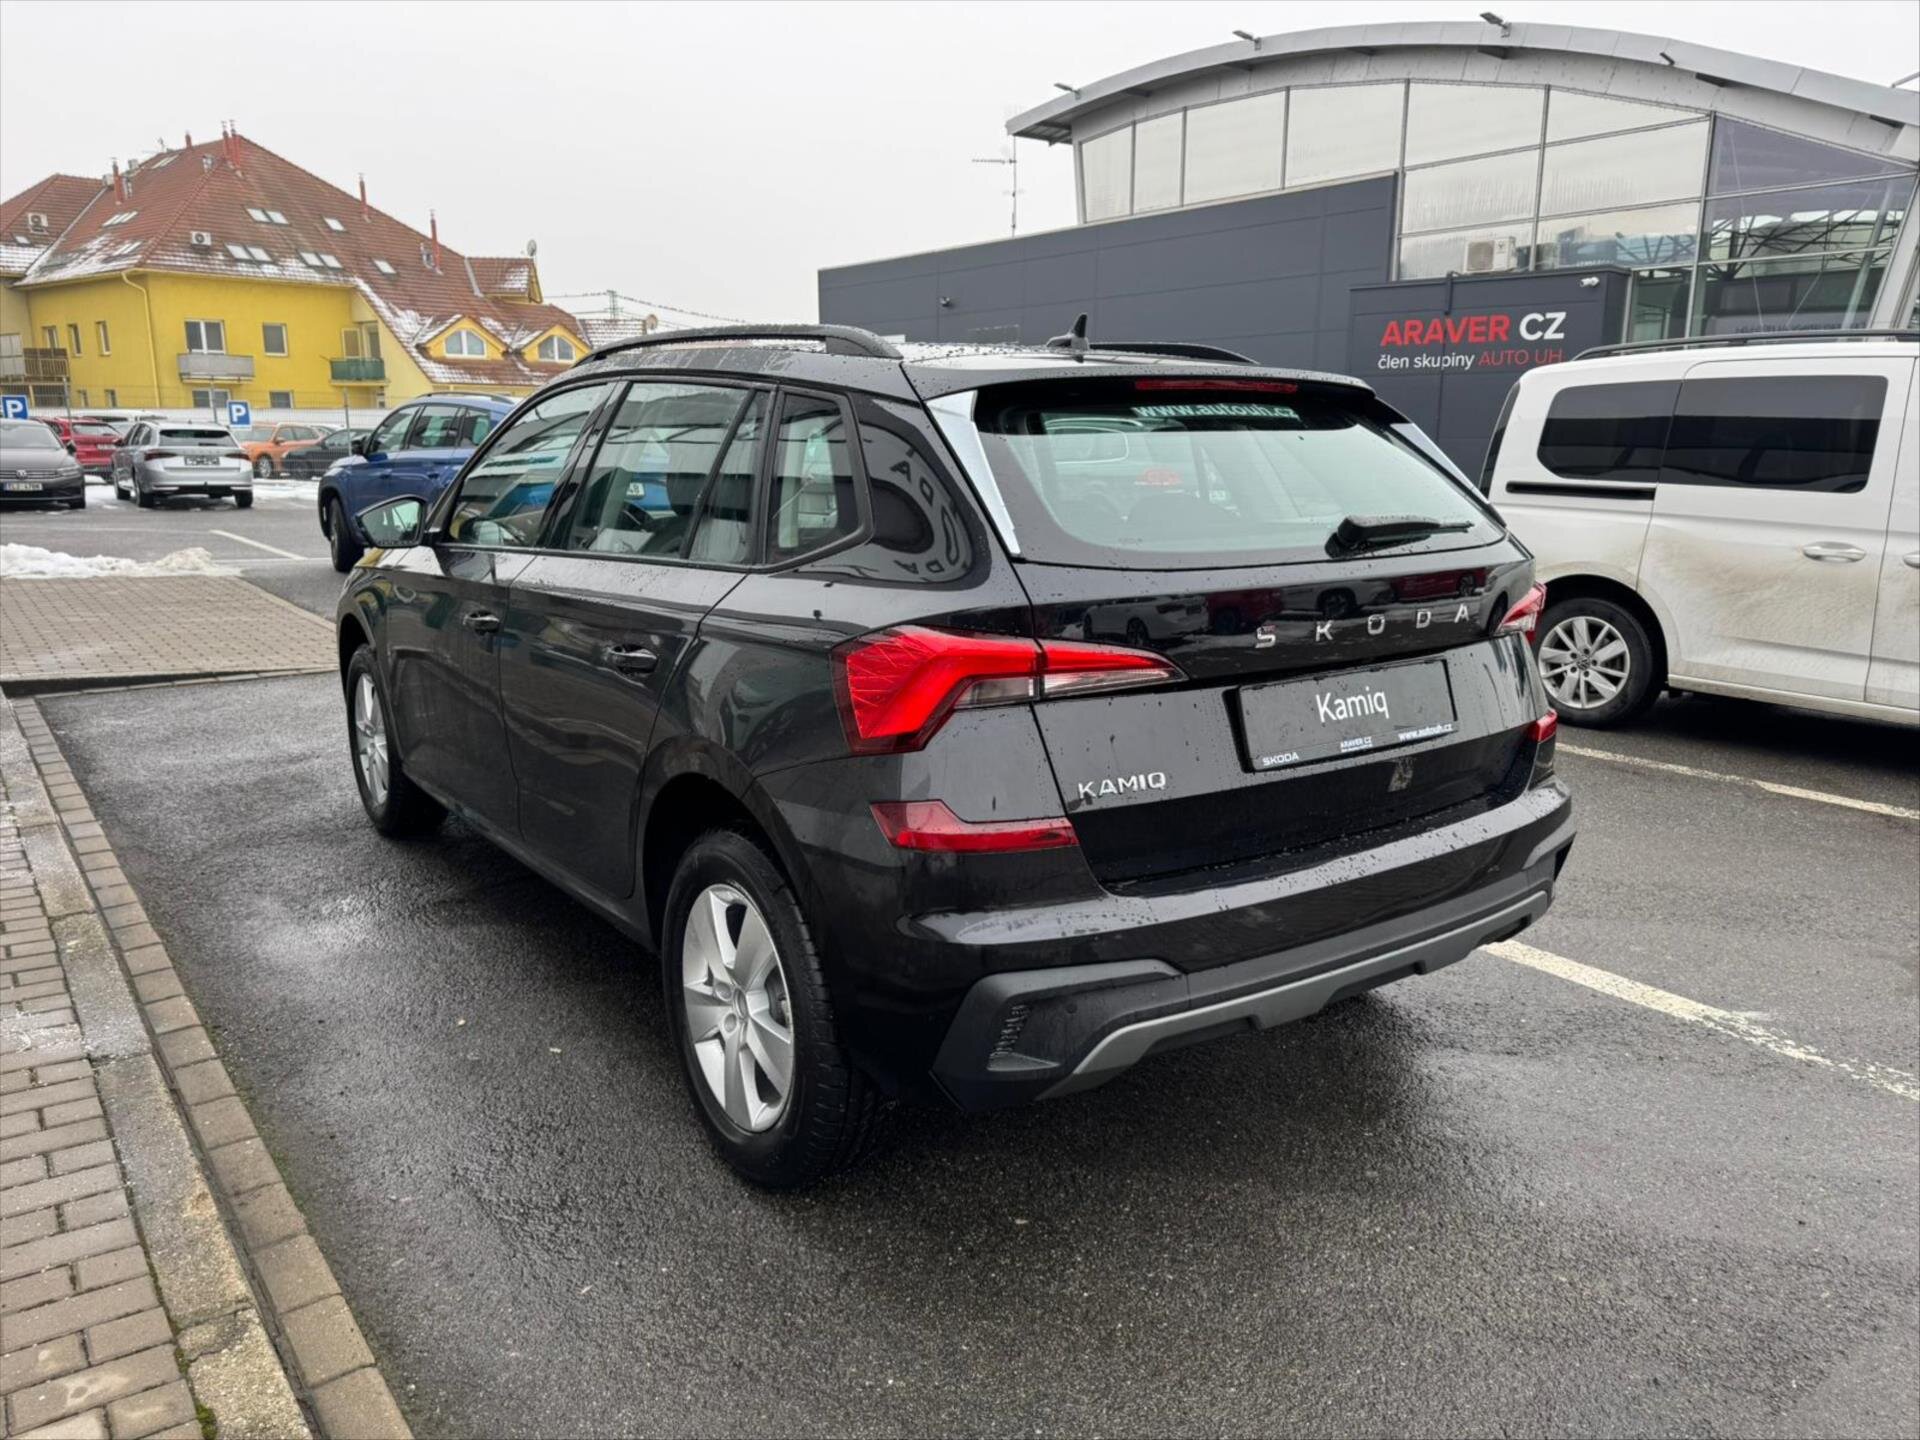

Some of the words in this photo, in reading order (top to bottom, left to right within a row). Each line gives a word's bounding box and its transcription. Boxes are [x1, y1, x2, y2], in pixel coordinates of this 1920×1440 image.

[1380, 315, 1510, 347] ARAVER
[1519, 311, 1567, 341] CZ
[1377, 354, 1410, 370] člen
[1413, 352, 1475, 371] skupiny
[1479, 350, 1530, 366] AUTO
[1535, 349, 1563, 364] UH
[231, 404, 246, 422] P
[1131, 403, 1299, 419] www.autouh.cz
[1316, 686, 1390, 723] Kamiq
[1078, 772, 1166, 799] KAMIQ
